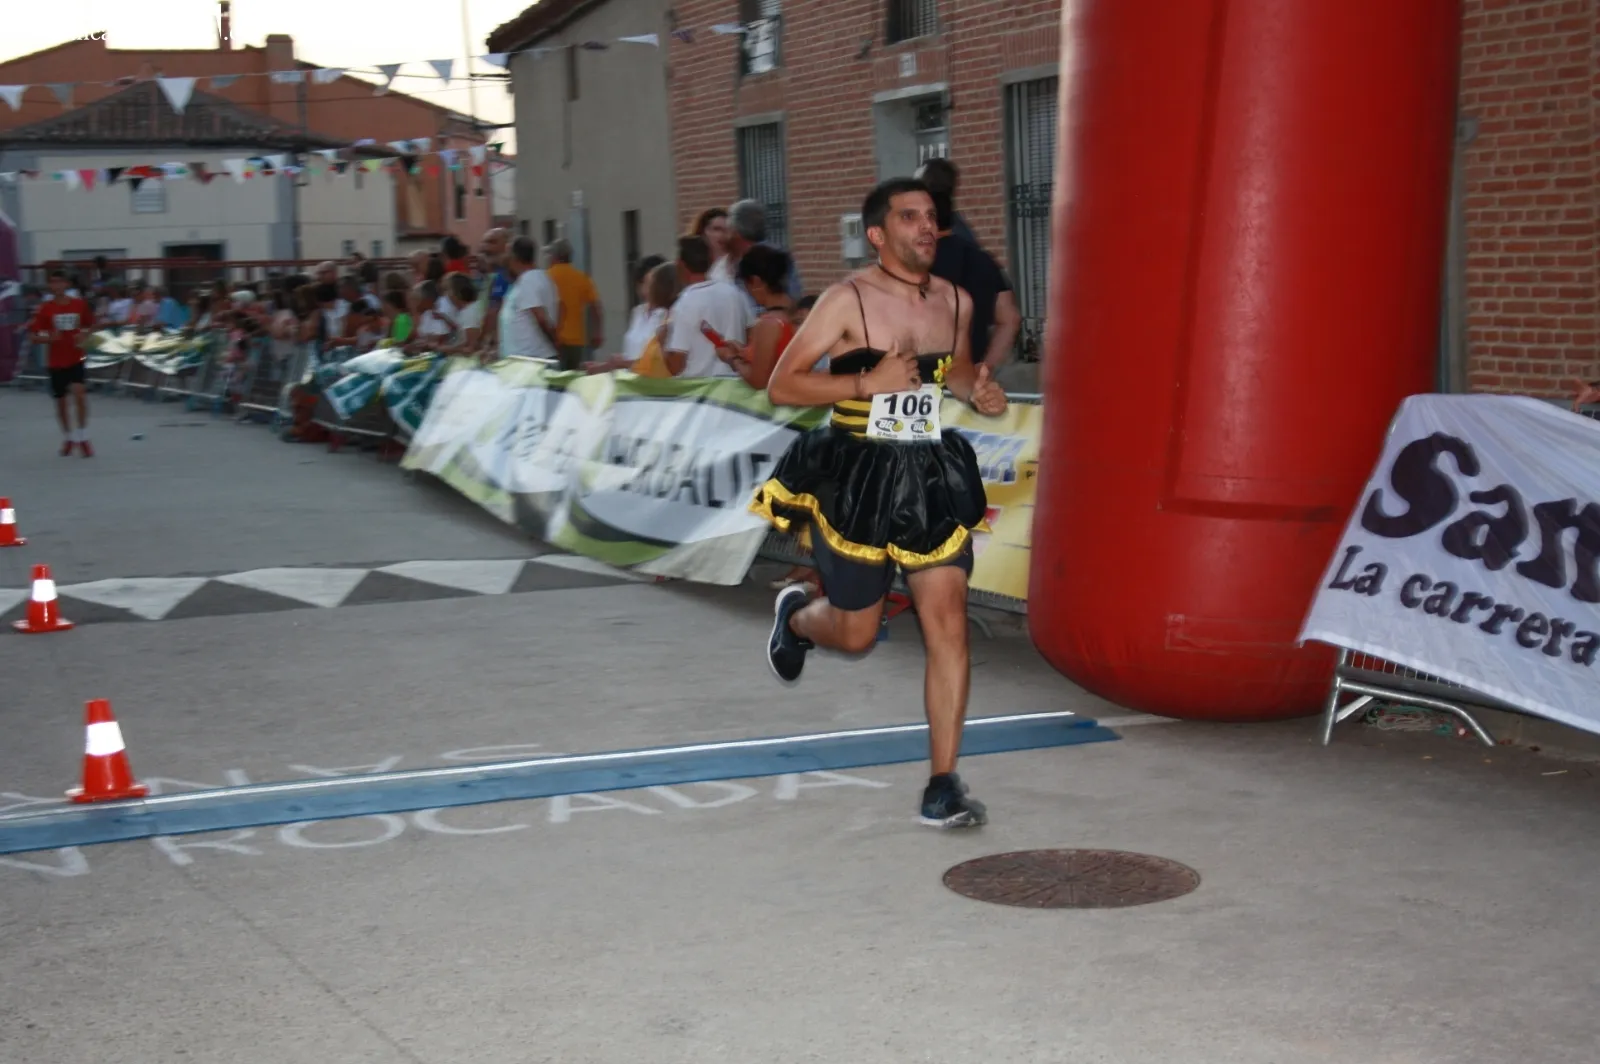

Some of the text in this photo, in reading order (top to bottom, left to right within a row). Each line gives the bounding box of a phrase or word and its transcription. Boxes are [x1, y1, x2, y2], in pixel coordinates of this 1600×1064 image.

[884, 394, 933, 416] 106
[1361, 431, 1600, 603] San
[1329, 545, 1600, 667] La carrera
